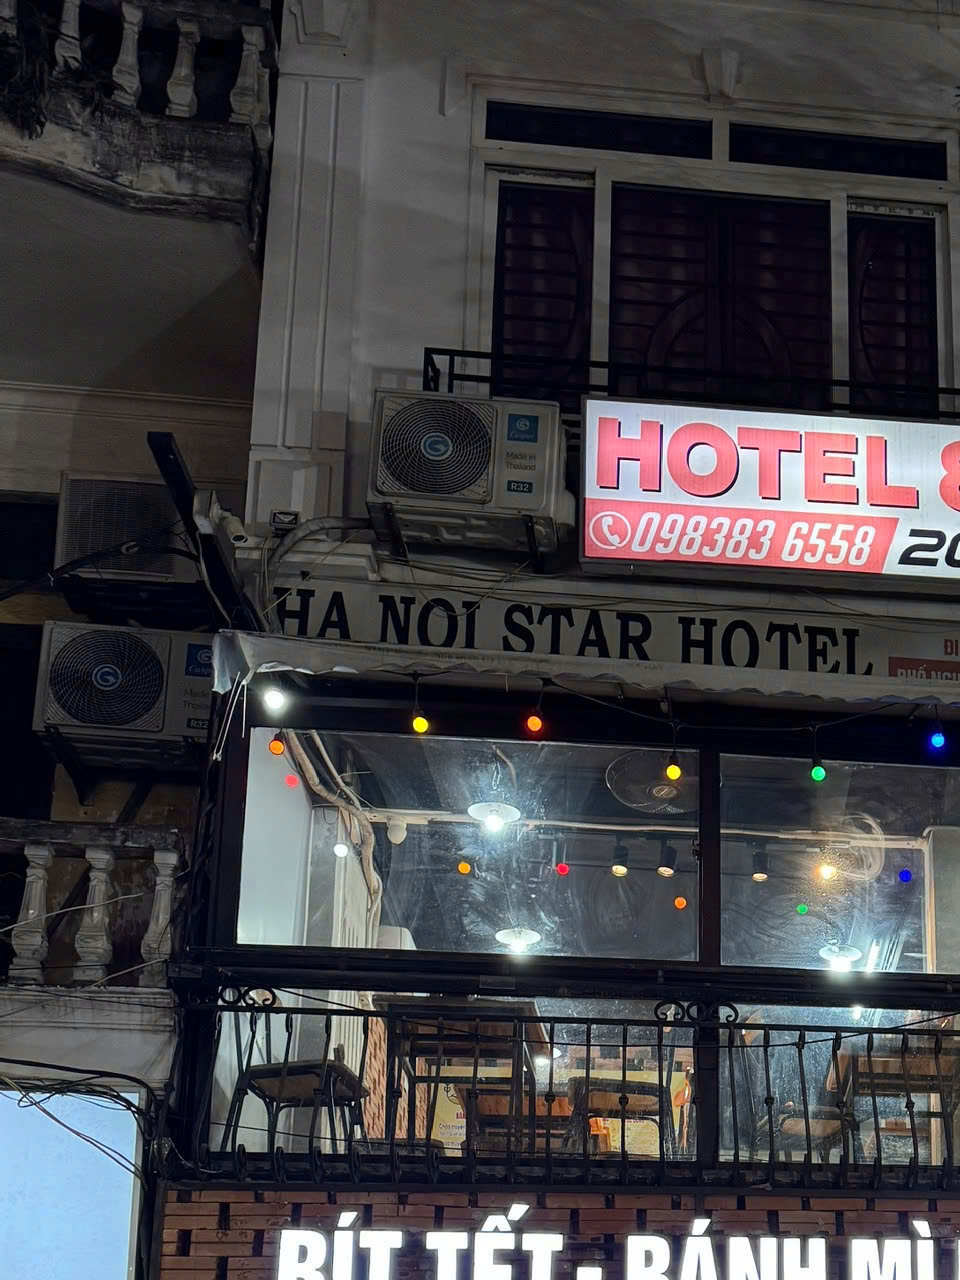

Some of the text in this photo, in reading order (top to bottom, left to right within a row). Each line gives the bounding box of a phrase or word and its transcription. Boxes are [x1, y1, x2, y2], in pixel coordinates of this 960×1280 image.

[511, 482, 529, 492] R32
[596, 416, 919, 509] HOTEL
[630, 511, 876, 566] 098383 6558
[502, 603, 653, 661] STAR
[678, 616, 874, 676] HOTEL
[943, 638, 959, 656] ĐI
